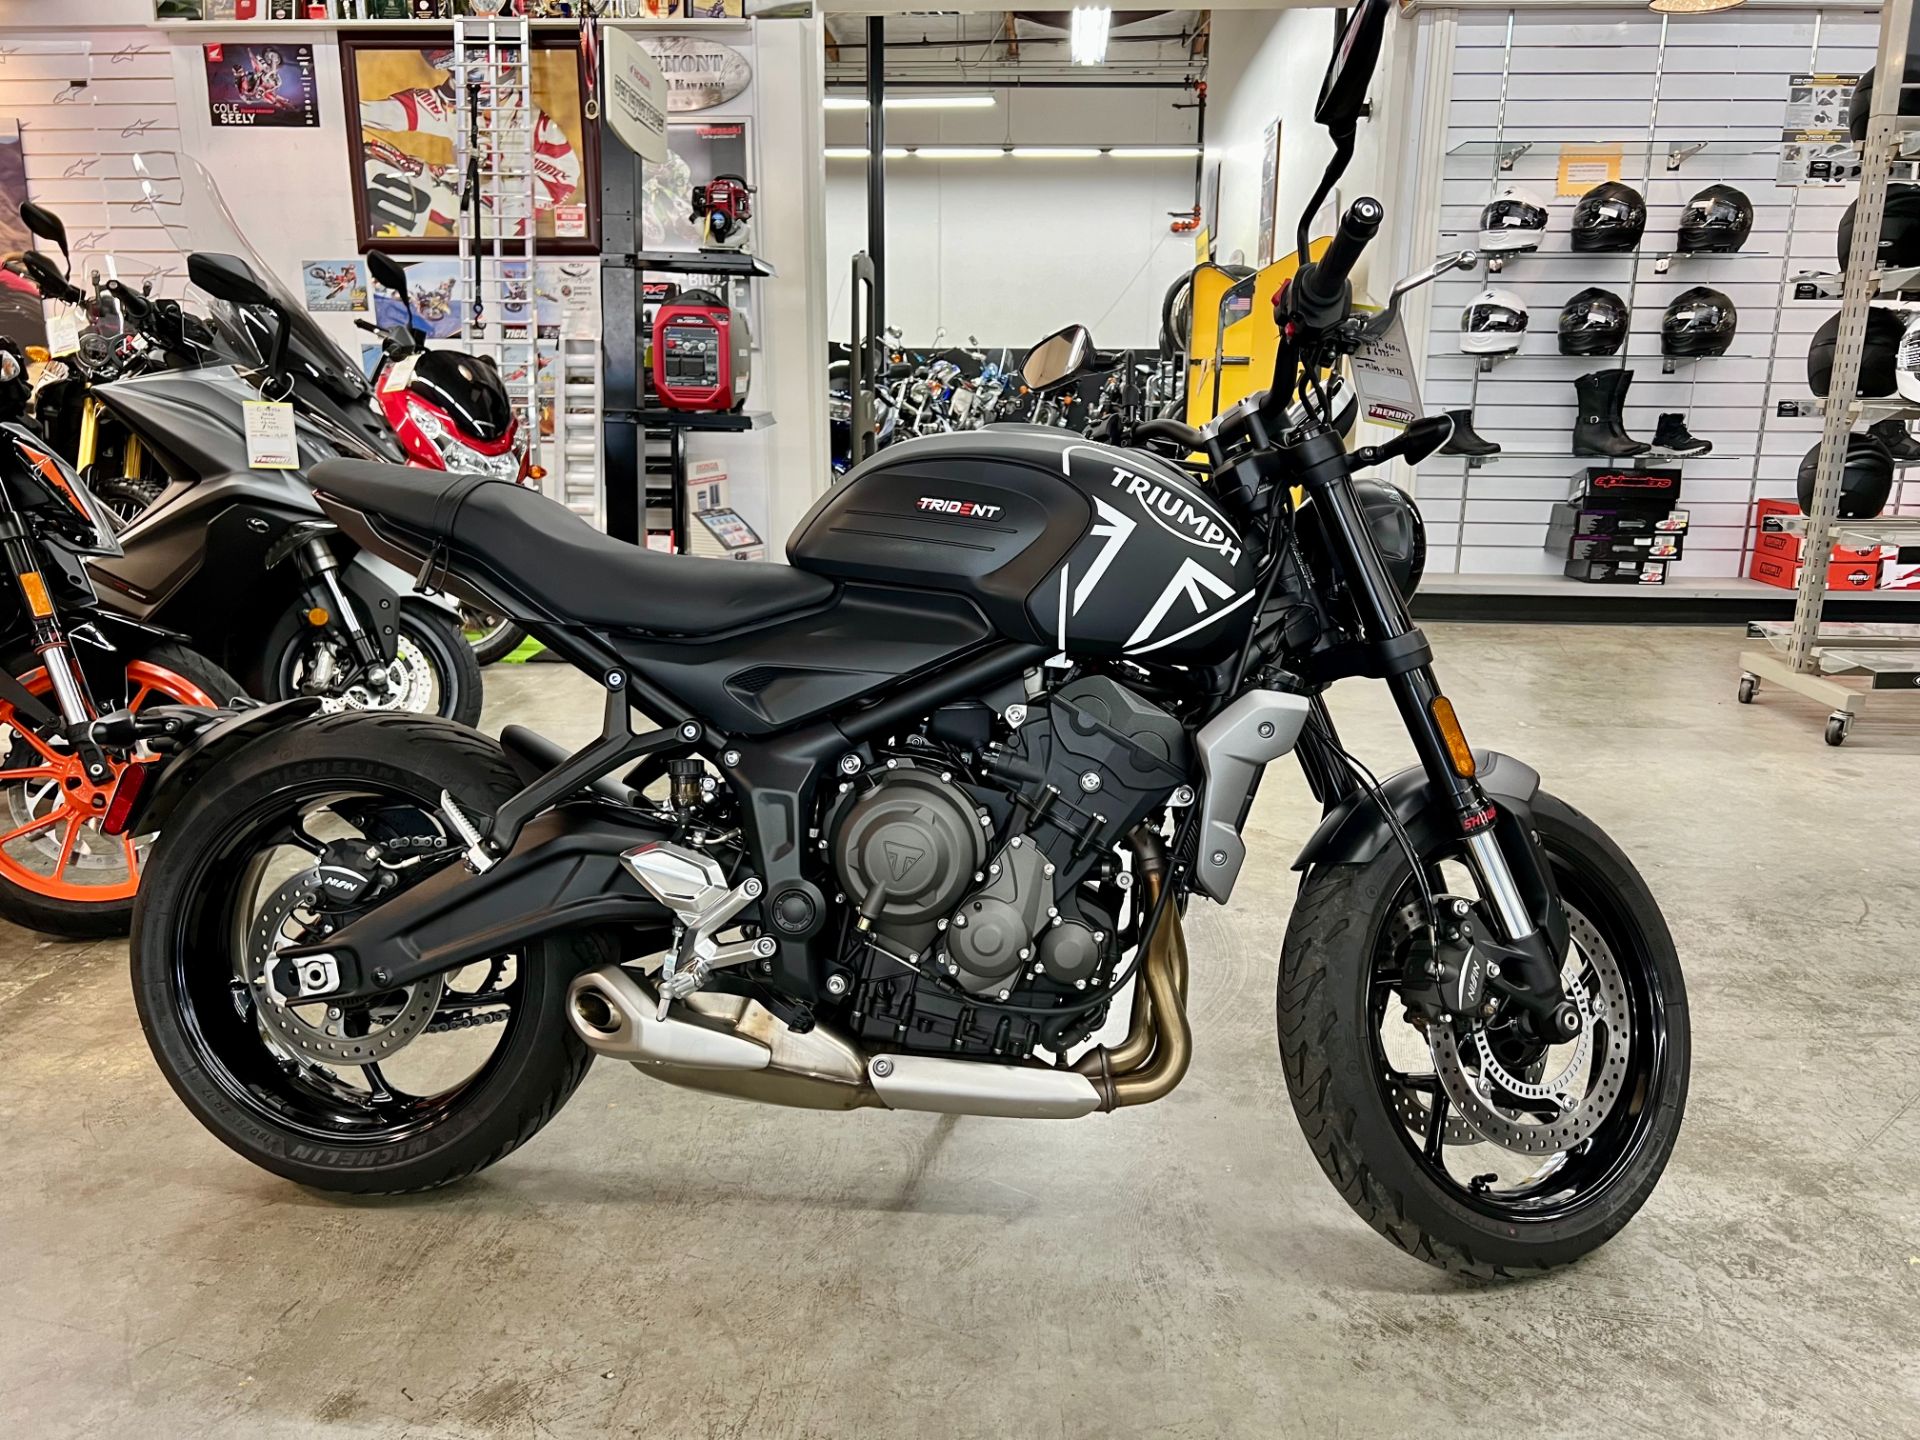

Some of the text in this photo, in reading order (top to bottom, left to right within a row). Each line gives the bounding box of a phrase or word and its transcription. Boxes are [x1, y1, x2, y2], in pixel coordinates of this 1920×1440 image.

[213, 103, 240, 114] COLE
[220, 113, 256, 124] SEELY
[1369, 405, 1415, 421] FREMONT
[920, 497, 1001, 518] TRIDENT
[1110, 466, 1242, 567] TRIUMPH
[324, 876, 358, 892] NISSIN
[1467, 960, 1481, 1002] NISSIN
[290, 1137, 429, 1167] MICHELIN
